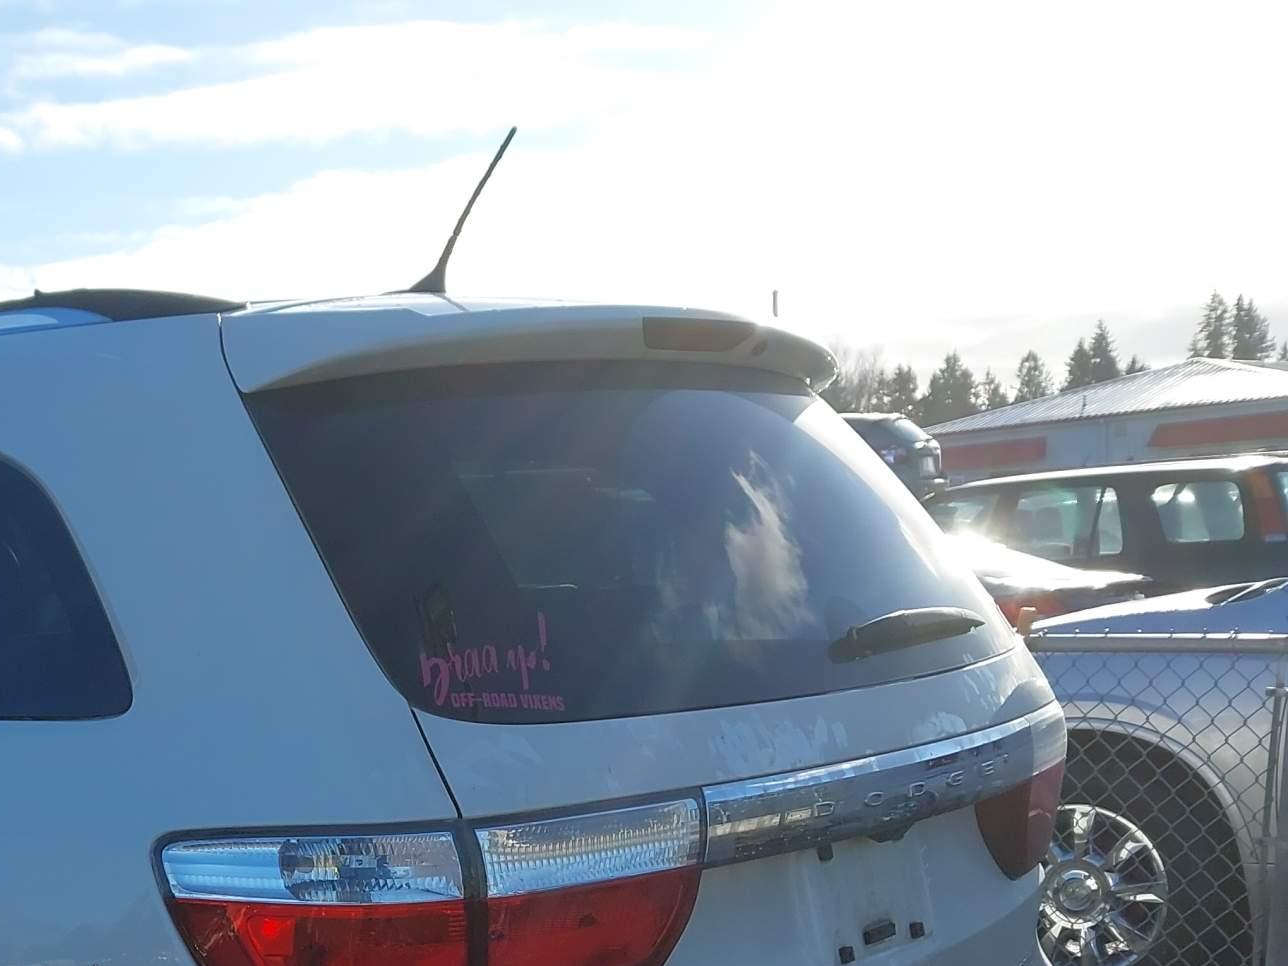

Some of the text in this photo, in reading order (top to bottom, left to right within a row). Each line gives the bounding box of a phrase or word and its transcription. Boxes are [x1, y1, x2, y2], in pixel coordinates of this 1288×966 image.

[451, 692, 566, 712] OFF-ROAD VIXENS
[812, 760, 996, 818] DODGE
